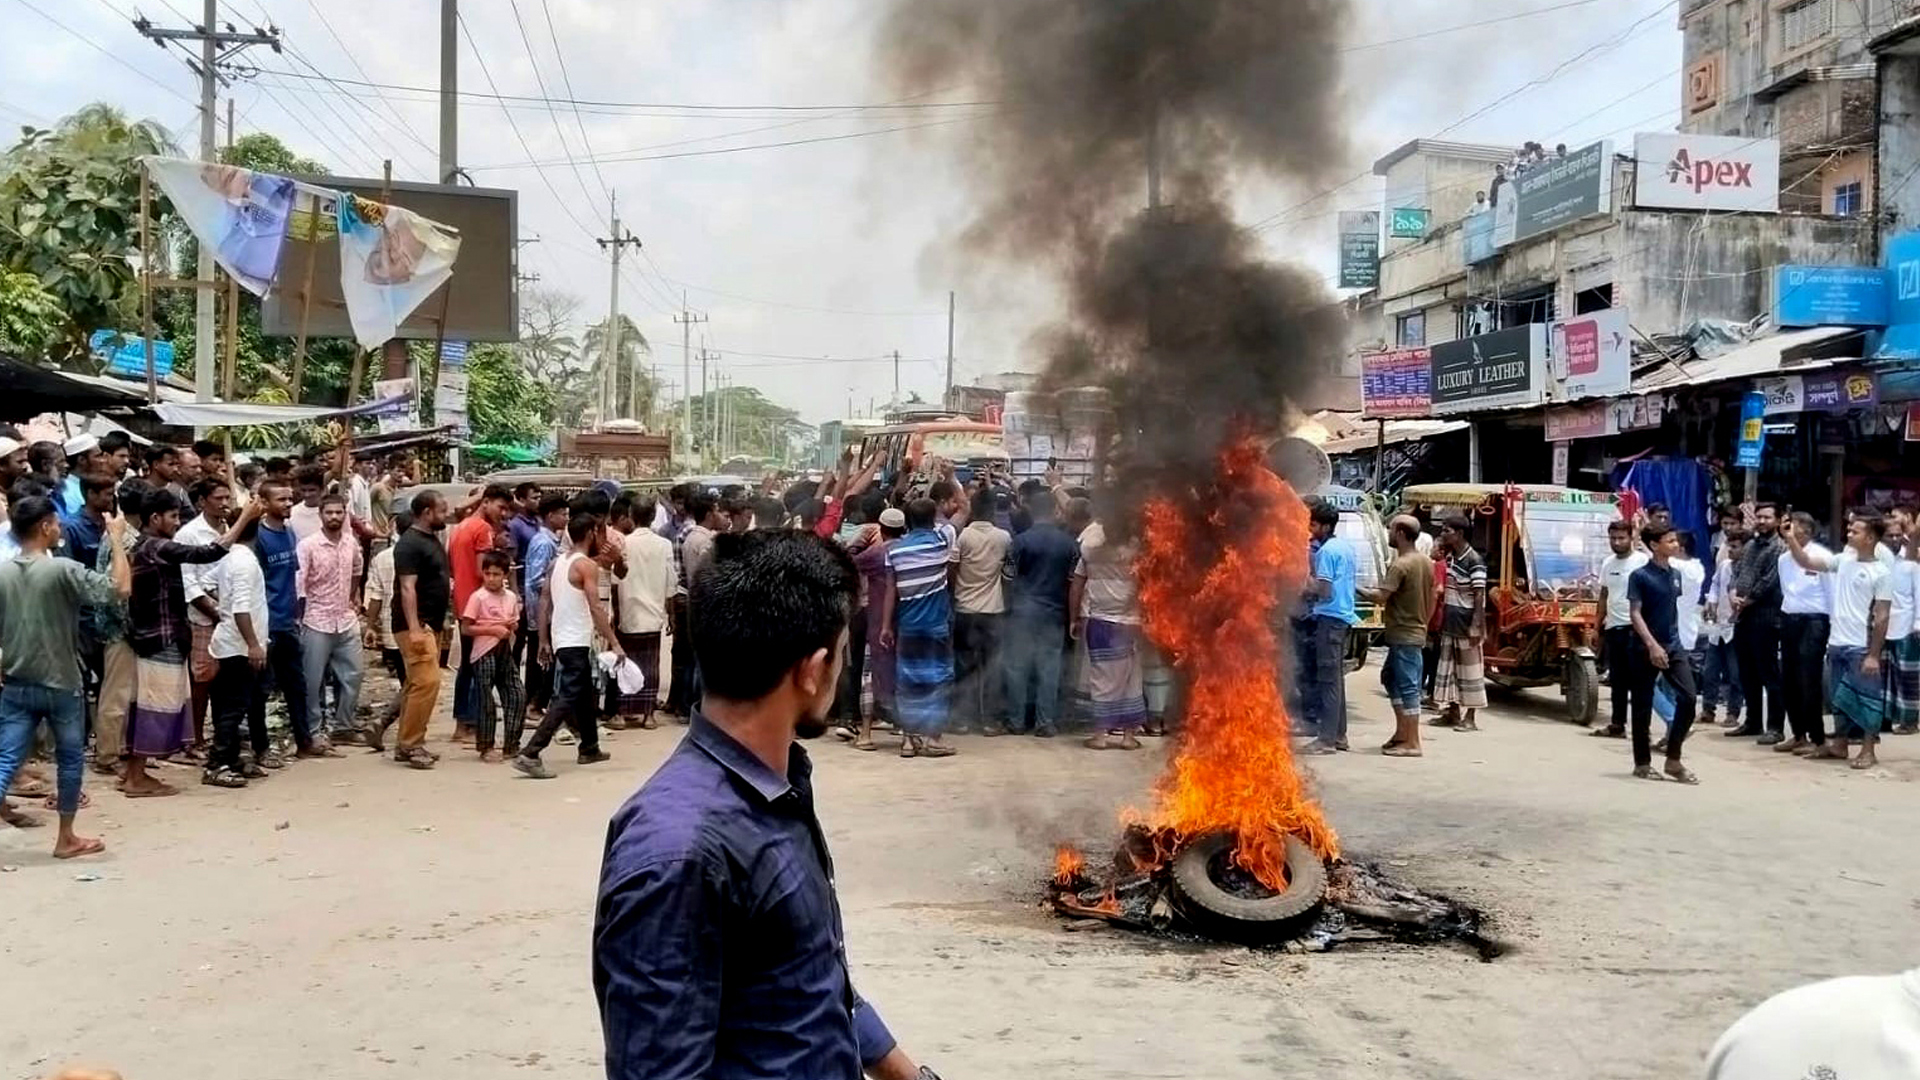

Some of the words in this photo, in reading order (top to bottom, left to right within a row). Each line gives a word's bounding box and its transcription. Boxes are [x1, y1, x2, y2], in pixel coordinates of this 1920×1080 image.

[1666, 148, 1752, 194] Apex
[1437, 369, 1474, 390] LUXURY
[1479, 361, 1525, 383] LEATHER
